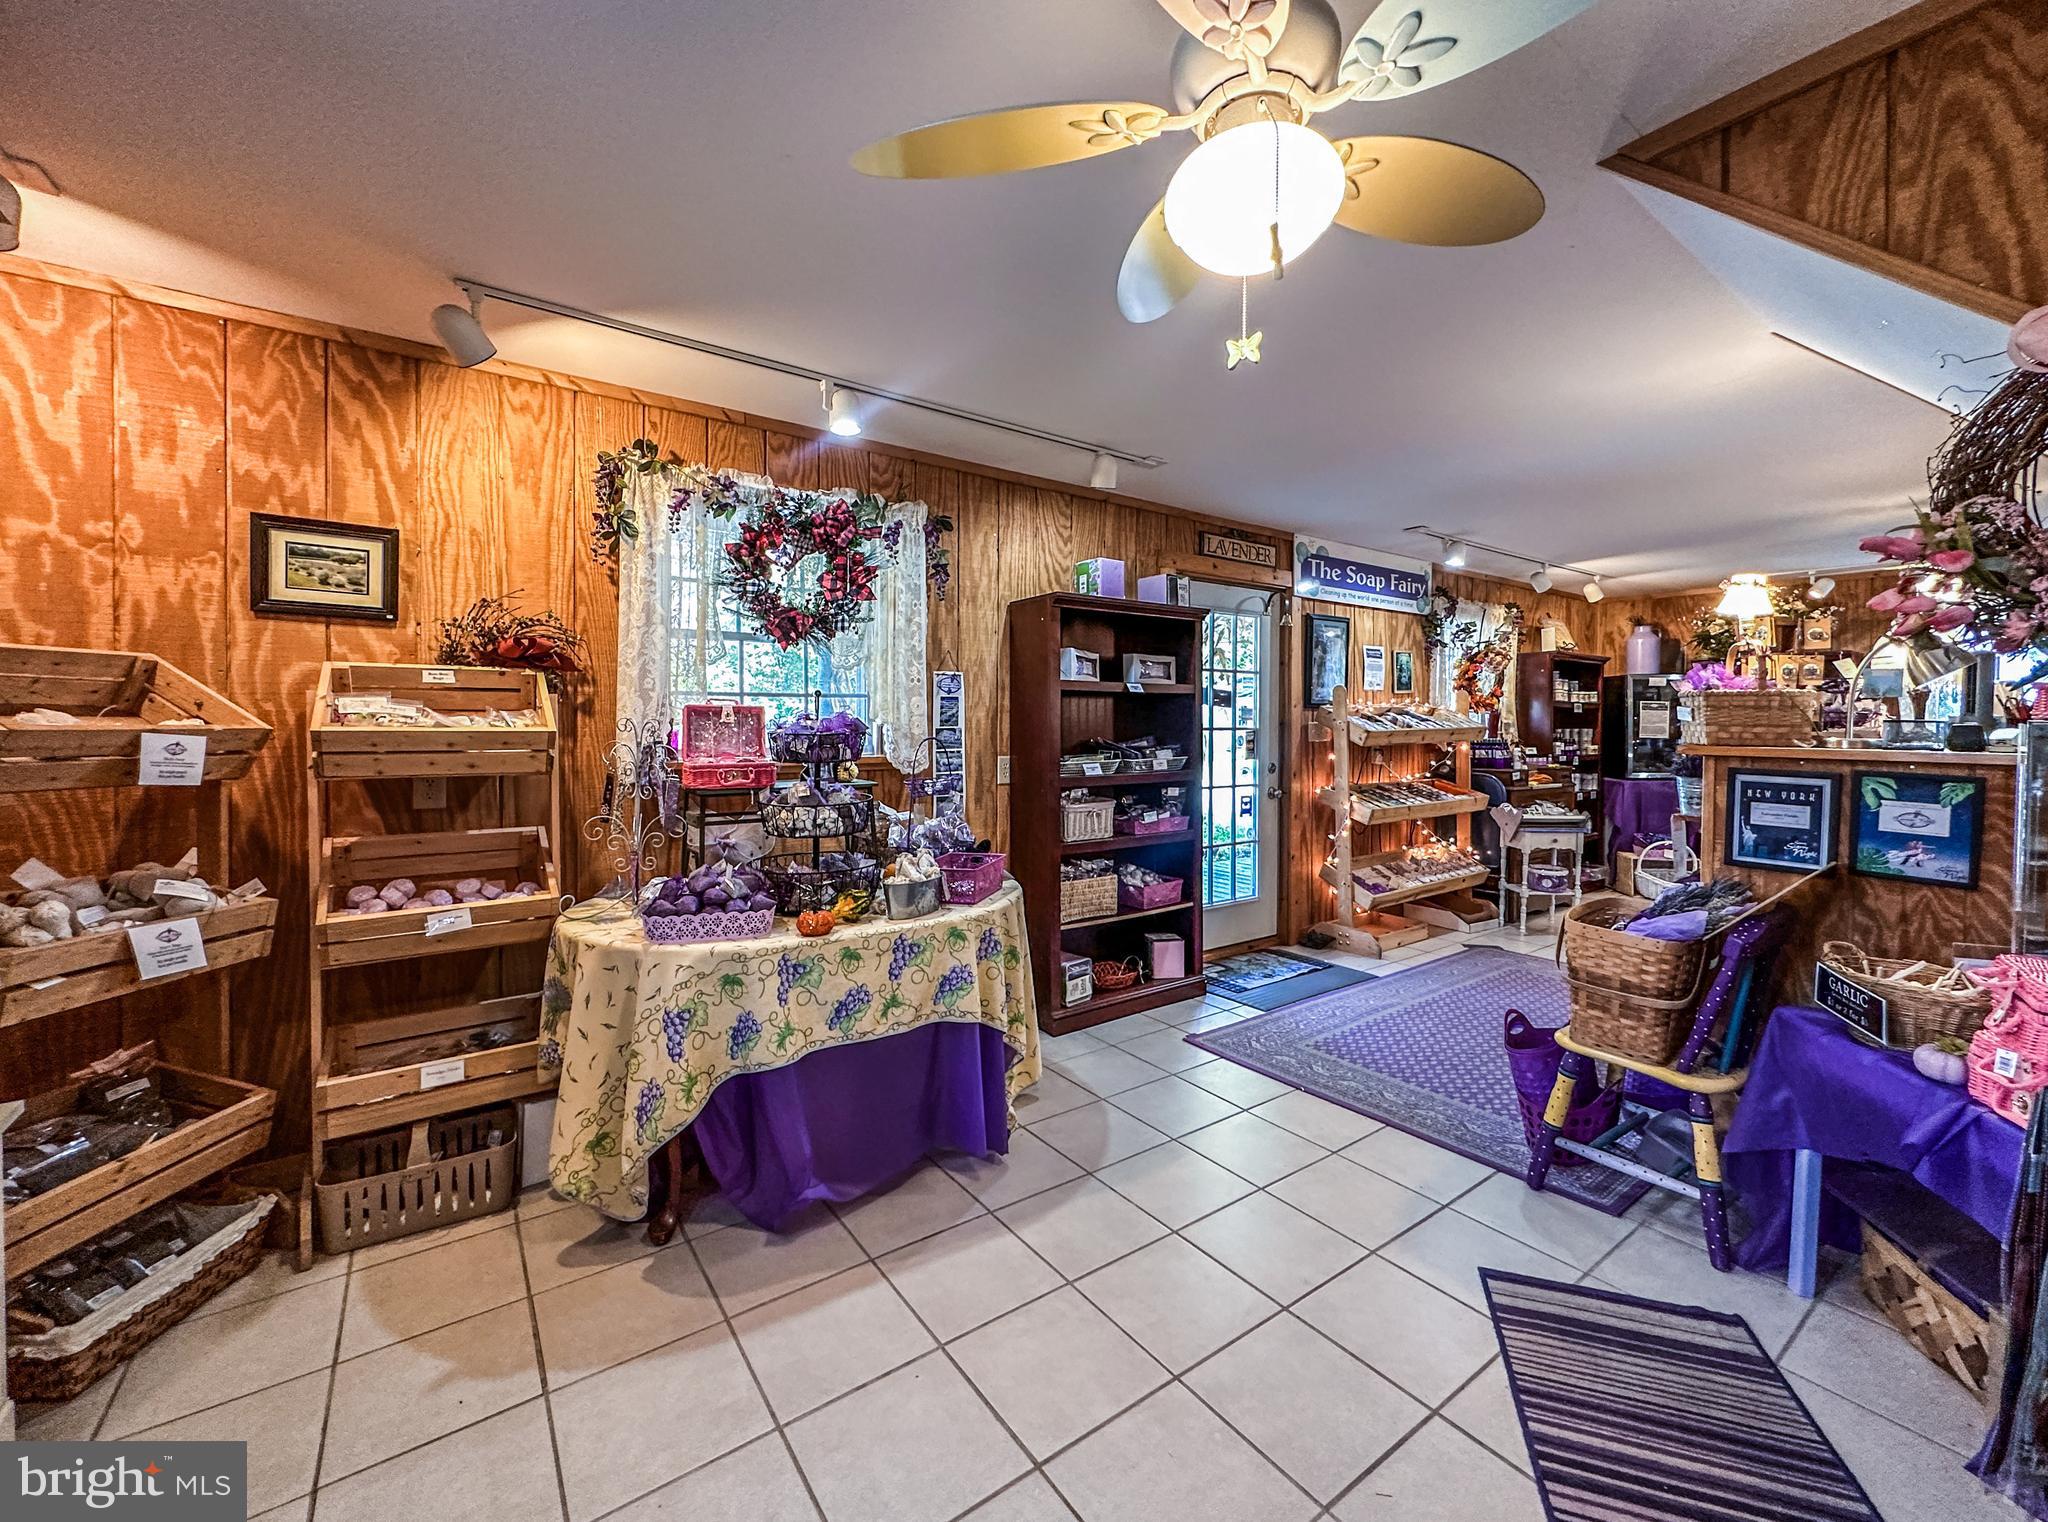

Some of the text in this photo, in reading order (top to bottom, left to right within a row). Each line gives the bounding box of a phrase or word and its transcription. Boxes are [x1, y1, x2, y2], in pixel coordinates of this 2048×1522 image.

[1206, 536, 1272, 564] LAVENDER
[1307, 558, 1426, 598] The Soap Fairy
[1320, 588, 1341, 598] Cleaning
[1348, 592, 1357, 600] the
[1747, 788, 1816, 802] NEW YORK
[1829, 977, 1868, 1008] GARLIC
[1849, 1009, 1859, 1021] for
